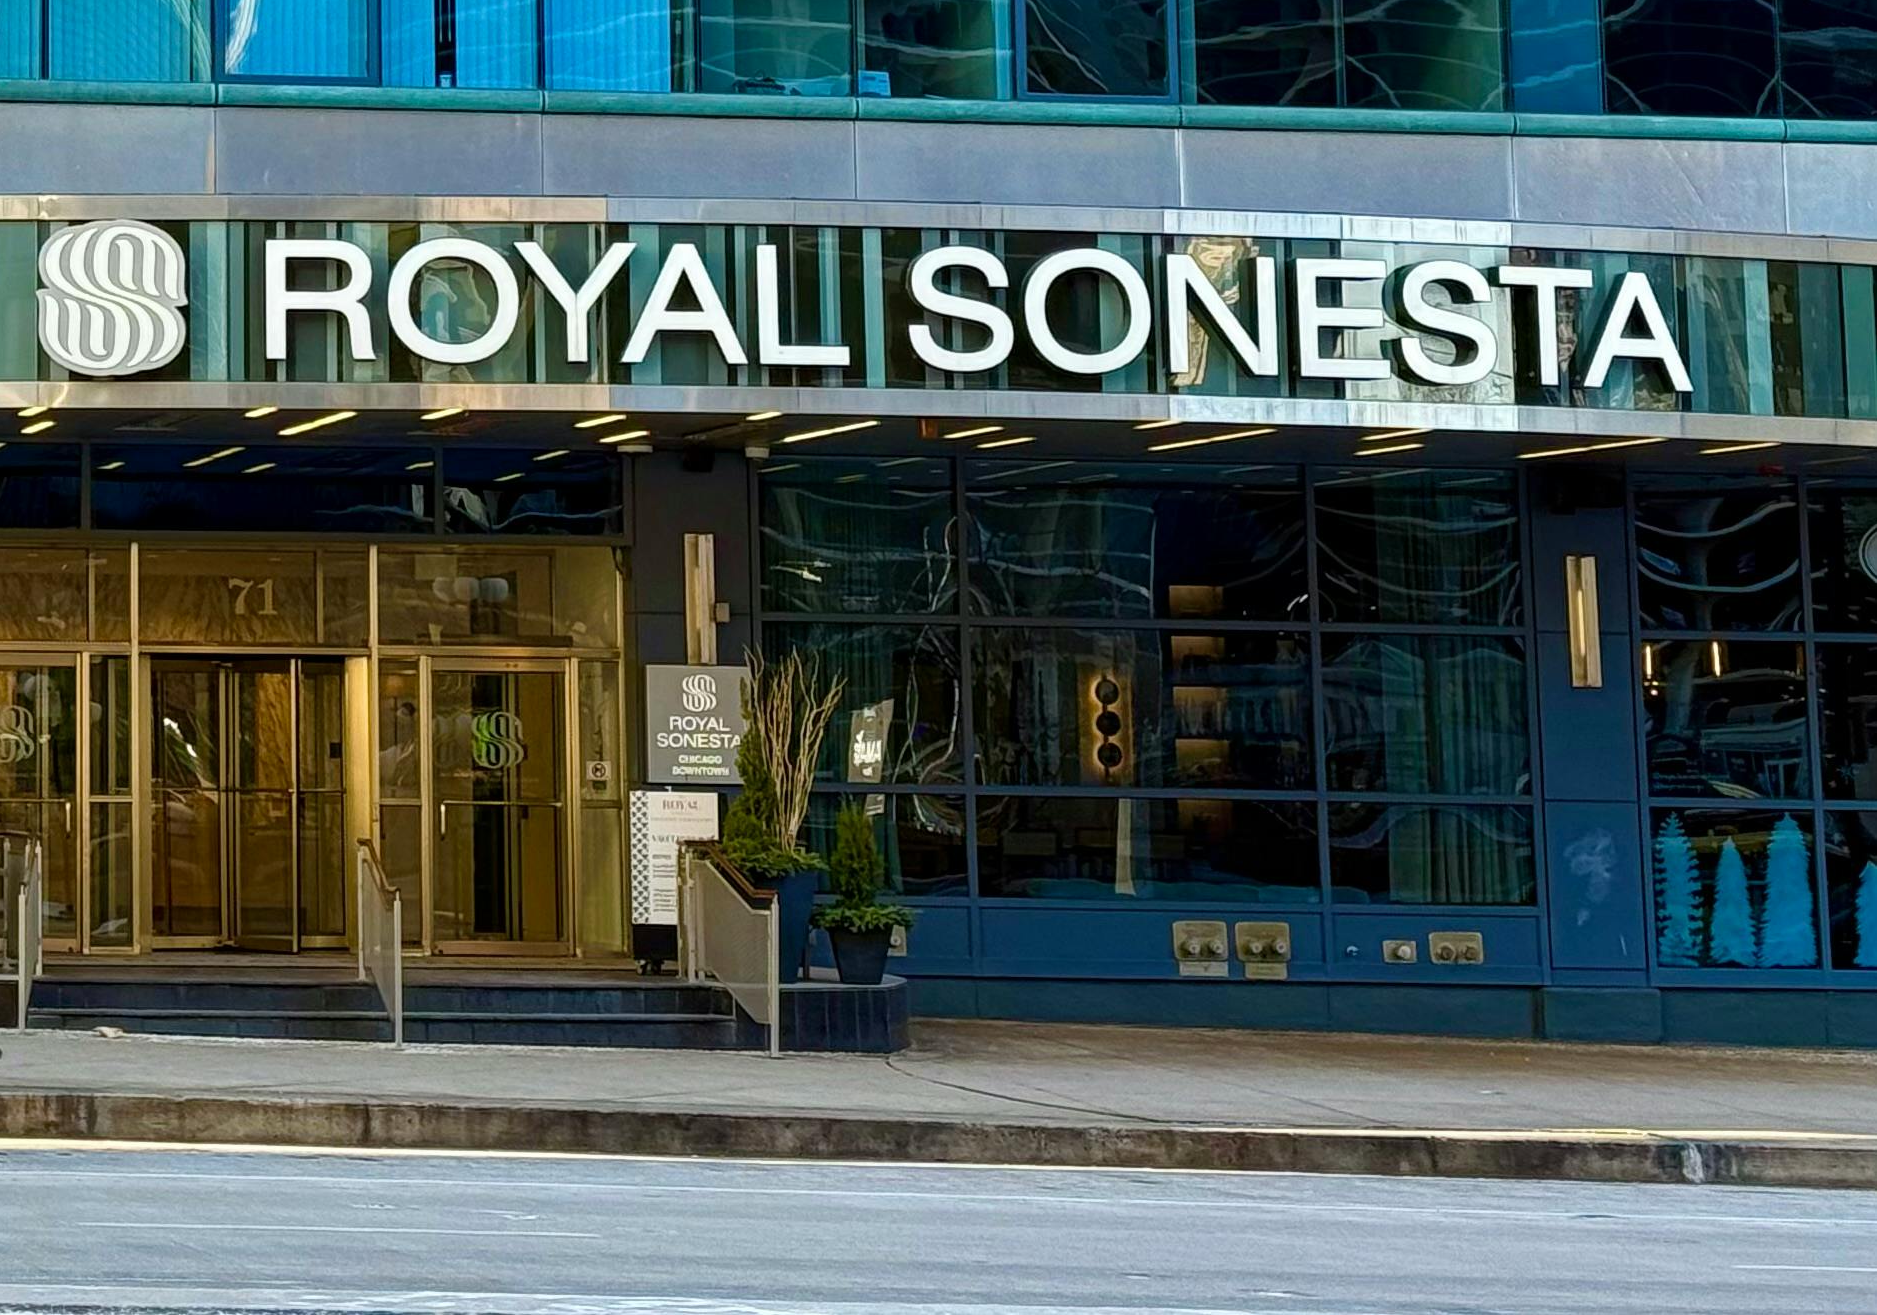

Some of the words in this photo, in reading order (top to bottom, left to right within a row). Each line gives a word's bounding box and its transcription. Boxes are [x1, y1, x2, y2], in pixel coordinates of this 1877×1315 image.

[264, 237, 851, 366] ROYAL
[907, 244, 1695, 393] SONESTA
[228, 578, 278, 615] 71
[669, 716, 731, 732] ROYAL
[656, 732, 741, 749] SONESTA
[678, 754, 723, 765] CHICAGO
[672, 766, 730, 777] DOWNTOWN
